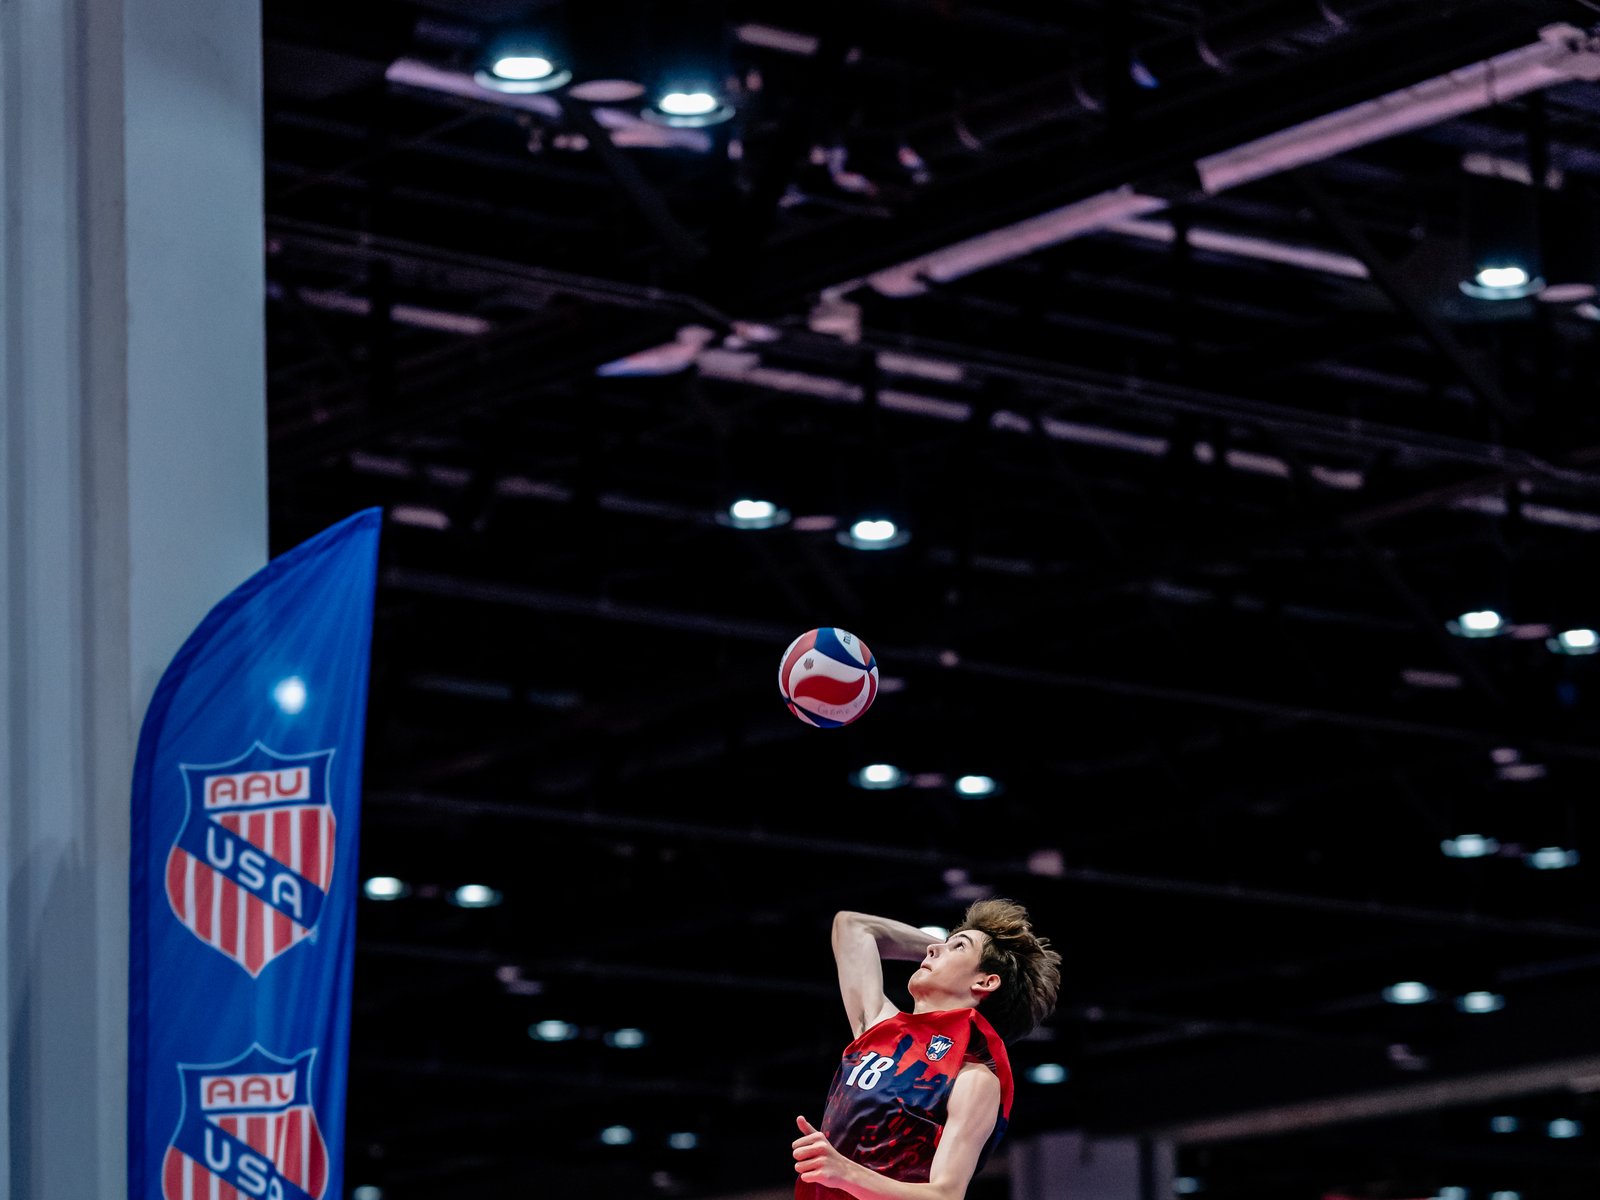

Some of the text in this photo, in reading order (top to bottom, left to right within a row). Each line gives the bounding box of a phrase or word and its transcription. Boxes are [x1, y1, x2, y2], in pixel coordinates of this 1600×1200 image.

[209, 770, 303, 805] AAU
[206, 826, 303, 919] USA
[845, 1051, 895, 1090] 18
